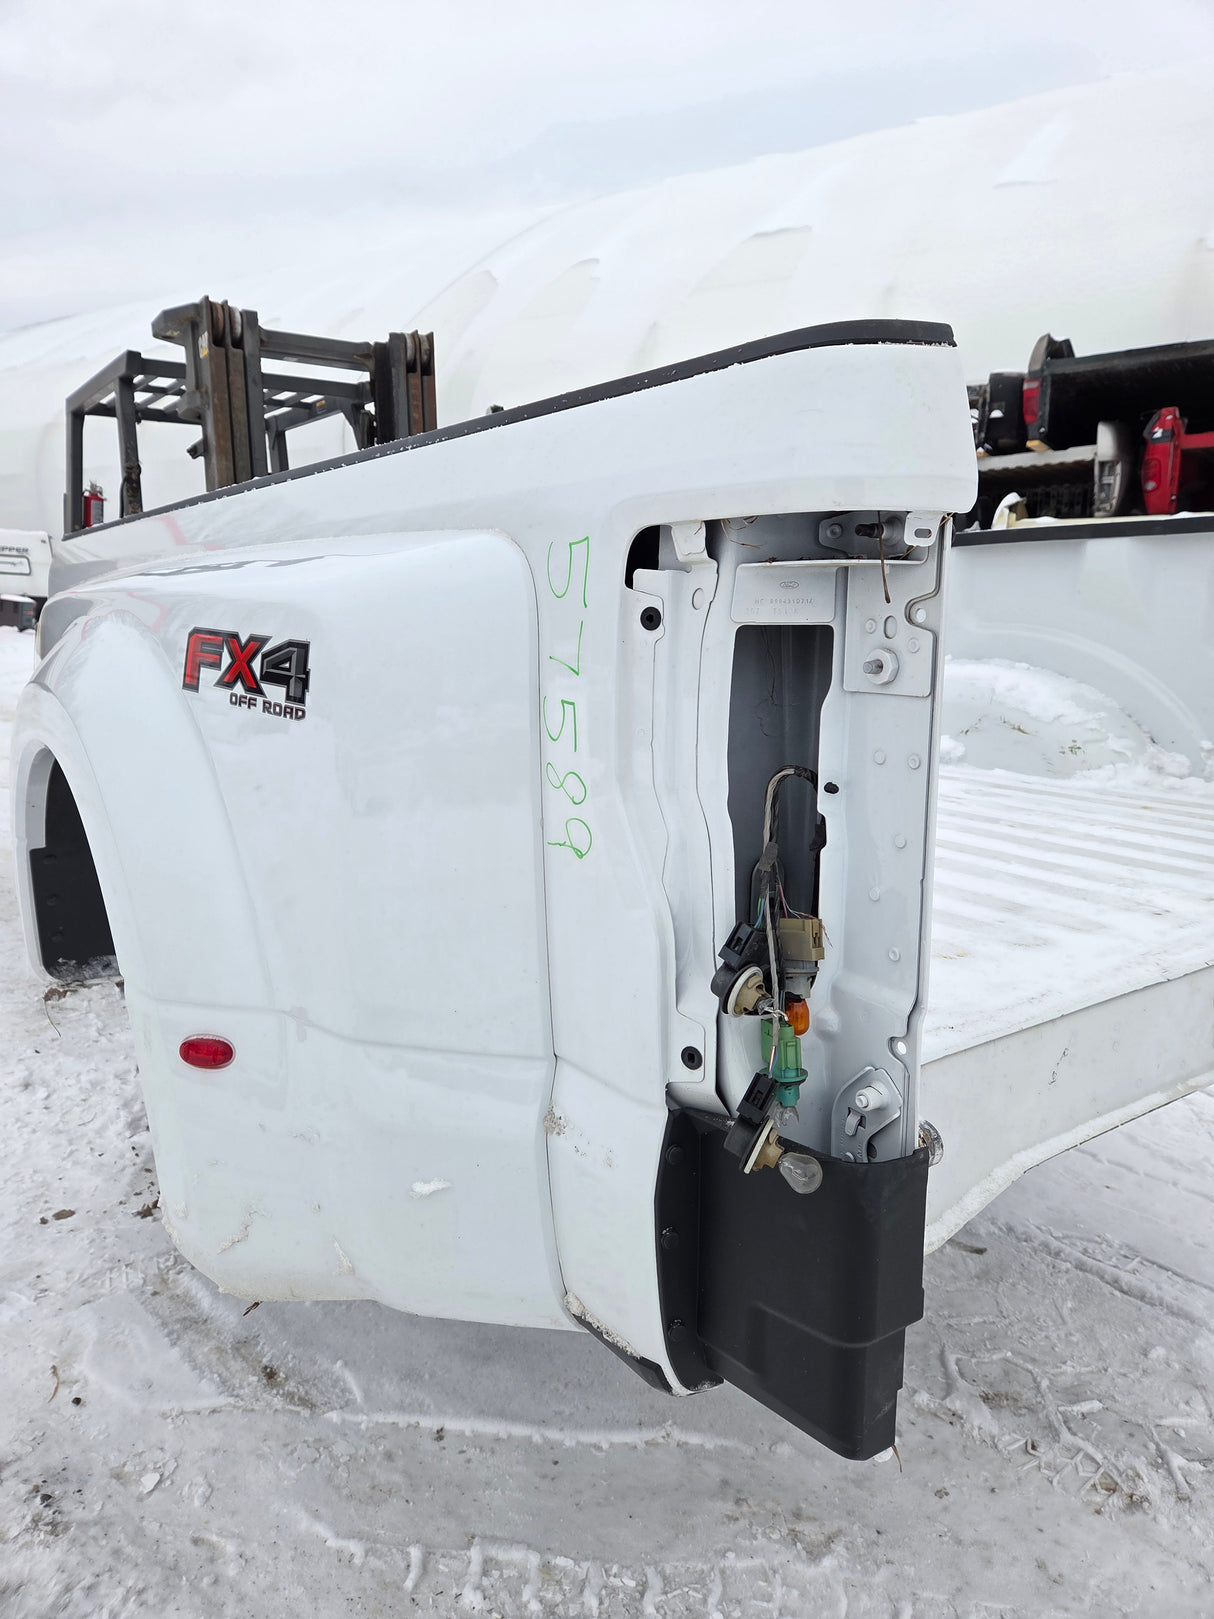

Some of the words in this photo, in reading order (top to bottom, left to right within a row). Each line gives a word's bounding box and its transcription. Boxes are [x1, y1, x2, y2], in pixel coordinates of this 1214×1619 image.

[181, 626, 311, 707] FX4
[229, 692, 258, 710] OFF
[262, 699, 306, 722] ROAD
